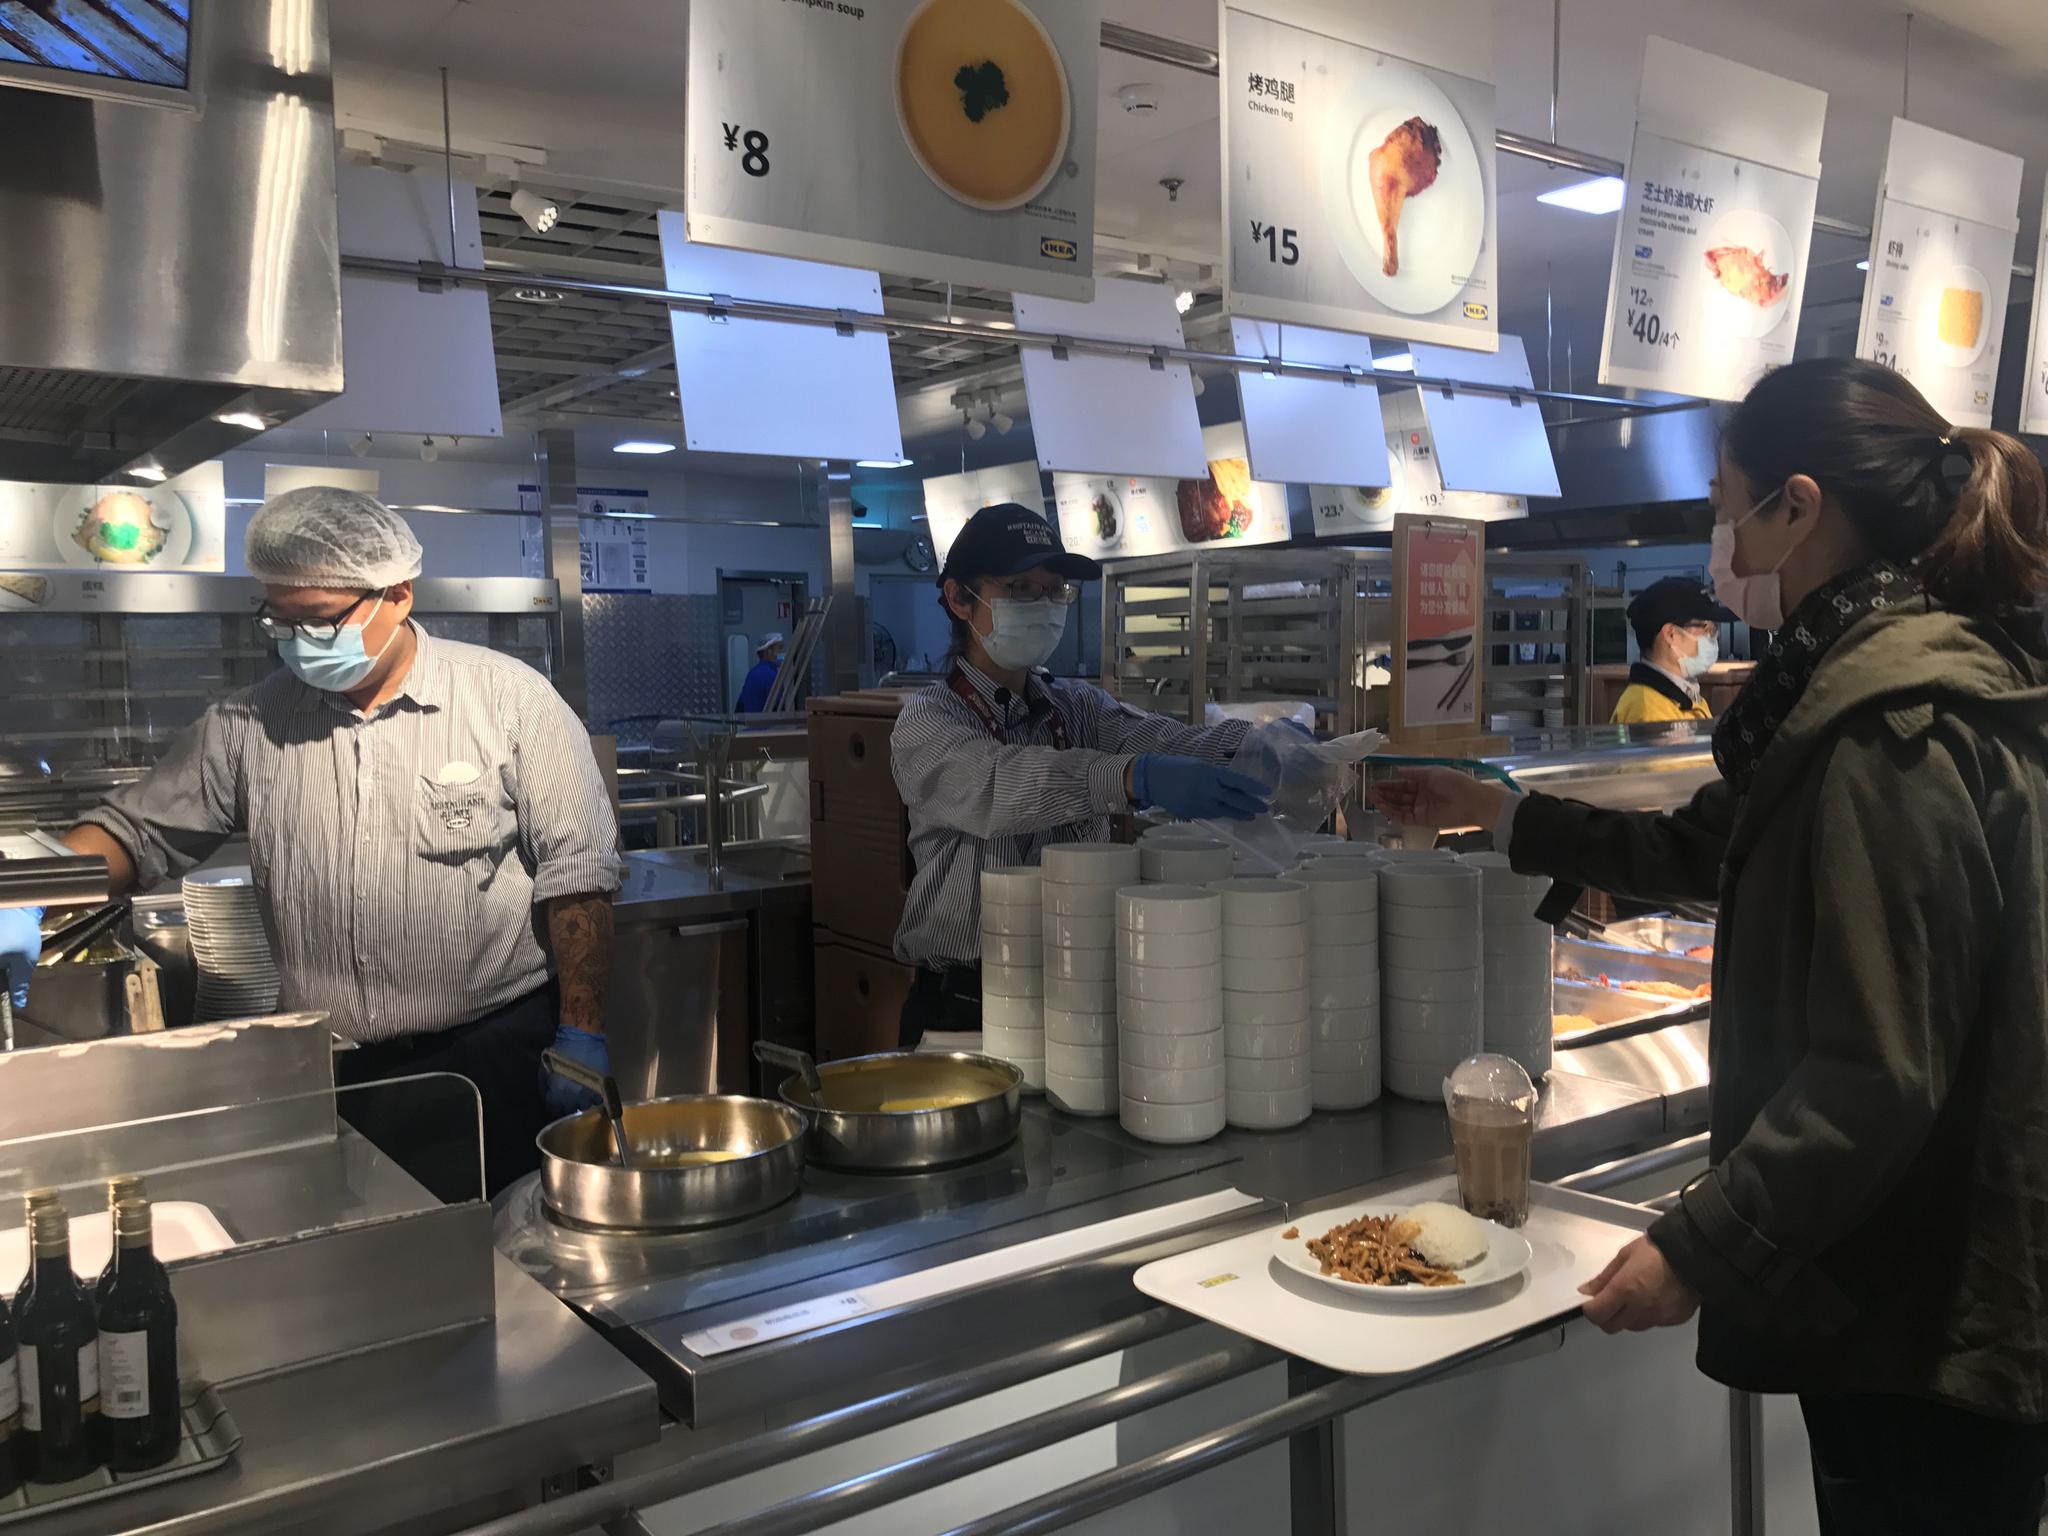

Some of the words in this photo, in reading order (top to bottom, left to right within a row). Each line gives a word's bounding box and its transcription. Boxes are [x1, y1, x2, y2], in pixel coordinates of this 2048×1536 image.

[837, 3, 865, 21] soup
[1248, 72, 1295, 104] 烤鸡腿
[1248, 100, 1279, 116] Chicken
[1281, 107, 1294, 121] leg
[722, 122, 770, 177] ¥8
[1251, 220, 1299, 266] ¥15
